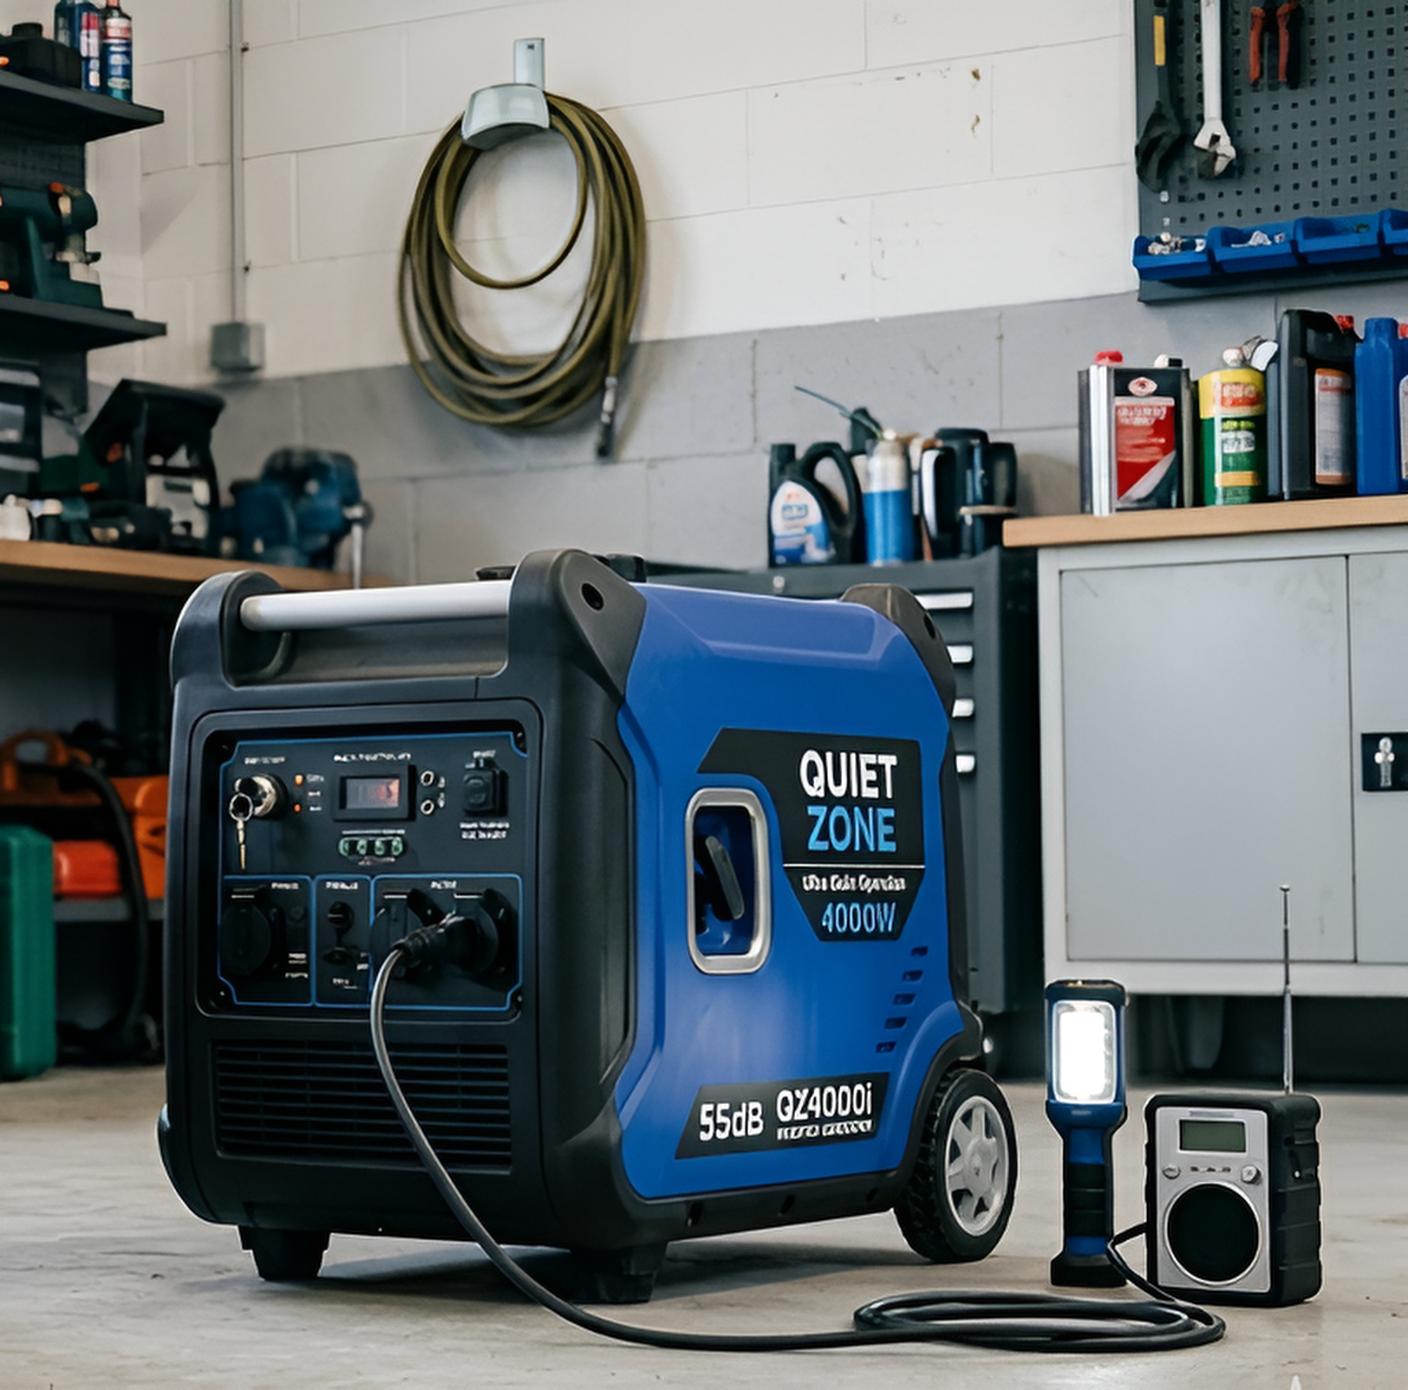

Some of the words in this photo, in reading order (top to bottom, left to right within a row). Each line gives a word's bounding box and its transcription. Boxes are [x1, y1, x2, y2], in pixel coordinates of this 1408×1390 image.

[800, 749, 897, 799] QUIET
[806, 805, 897, 852] ZONE
[822, 902, 896, 933] 4000W
[699, 1101, 764, 1141] 55dB
